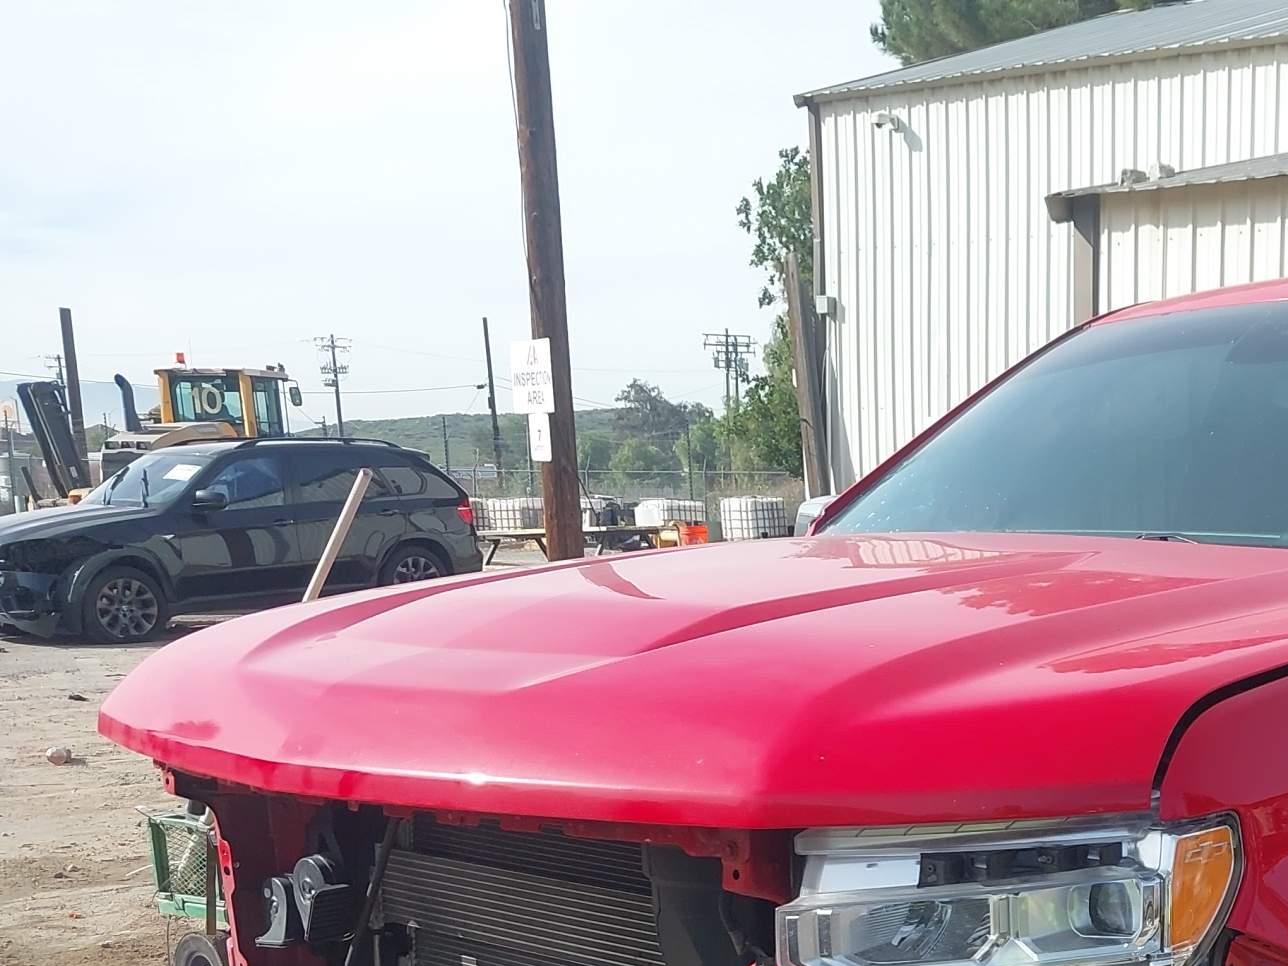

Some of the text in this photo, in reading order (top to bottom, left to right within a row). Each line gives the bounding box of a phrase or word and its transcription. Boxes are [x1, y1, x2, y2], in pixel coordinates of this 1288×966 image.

[513, 371, 551, 387] INSPECTION
[192, 386, 223, 414] 10
[527, 391, 545, 404] AREA
